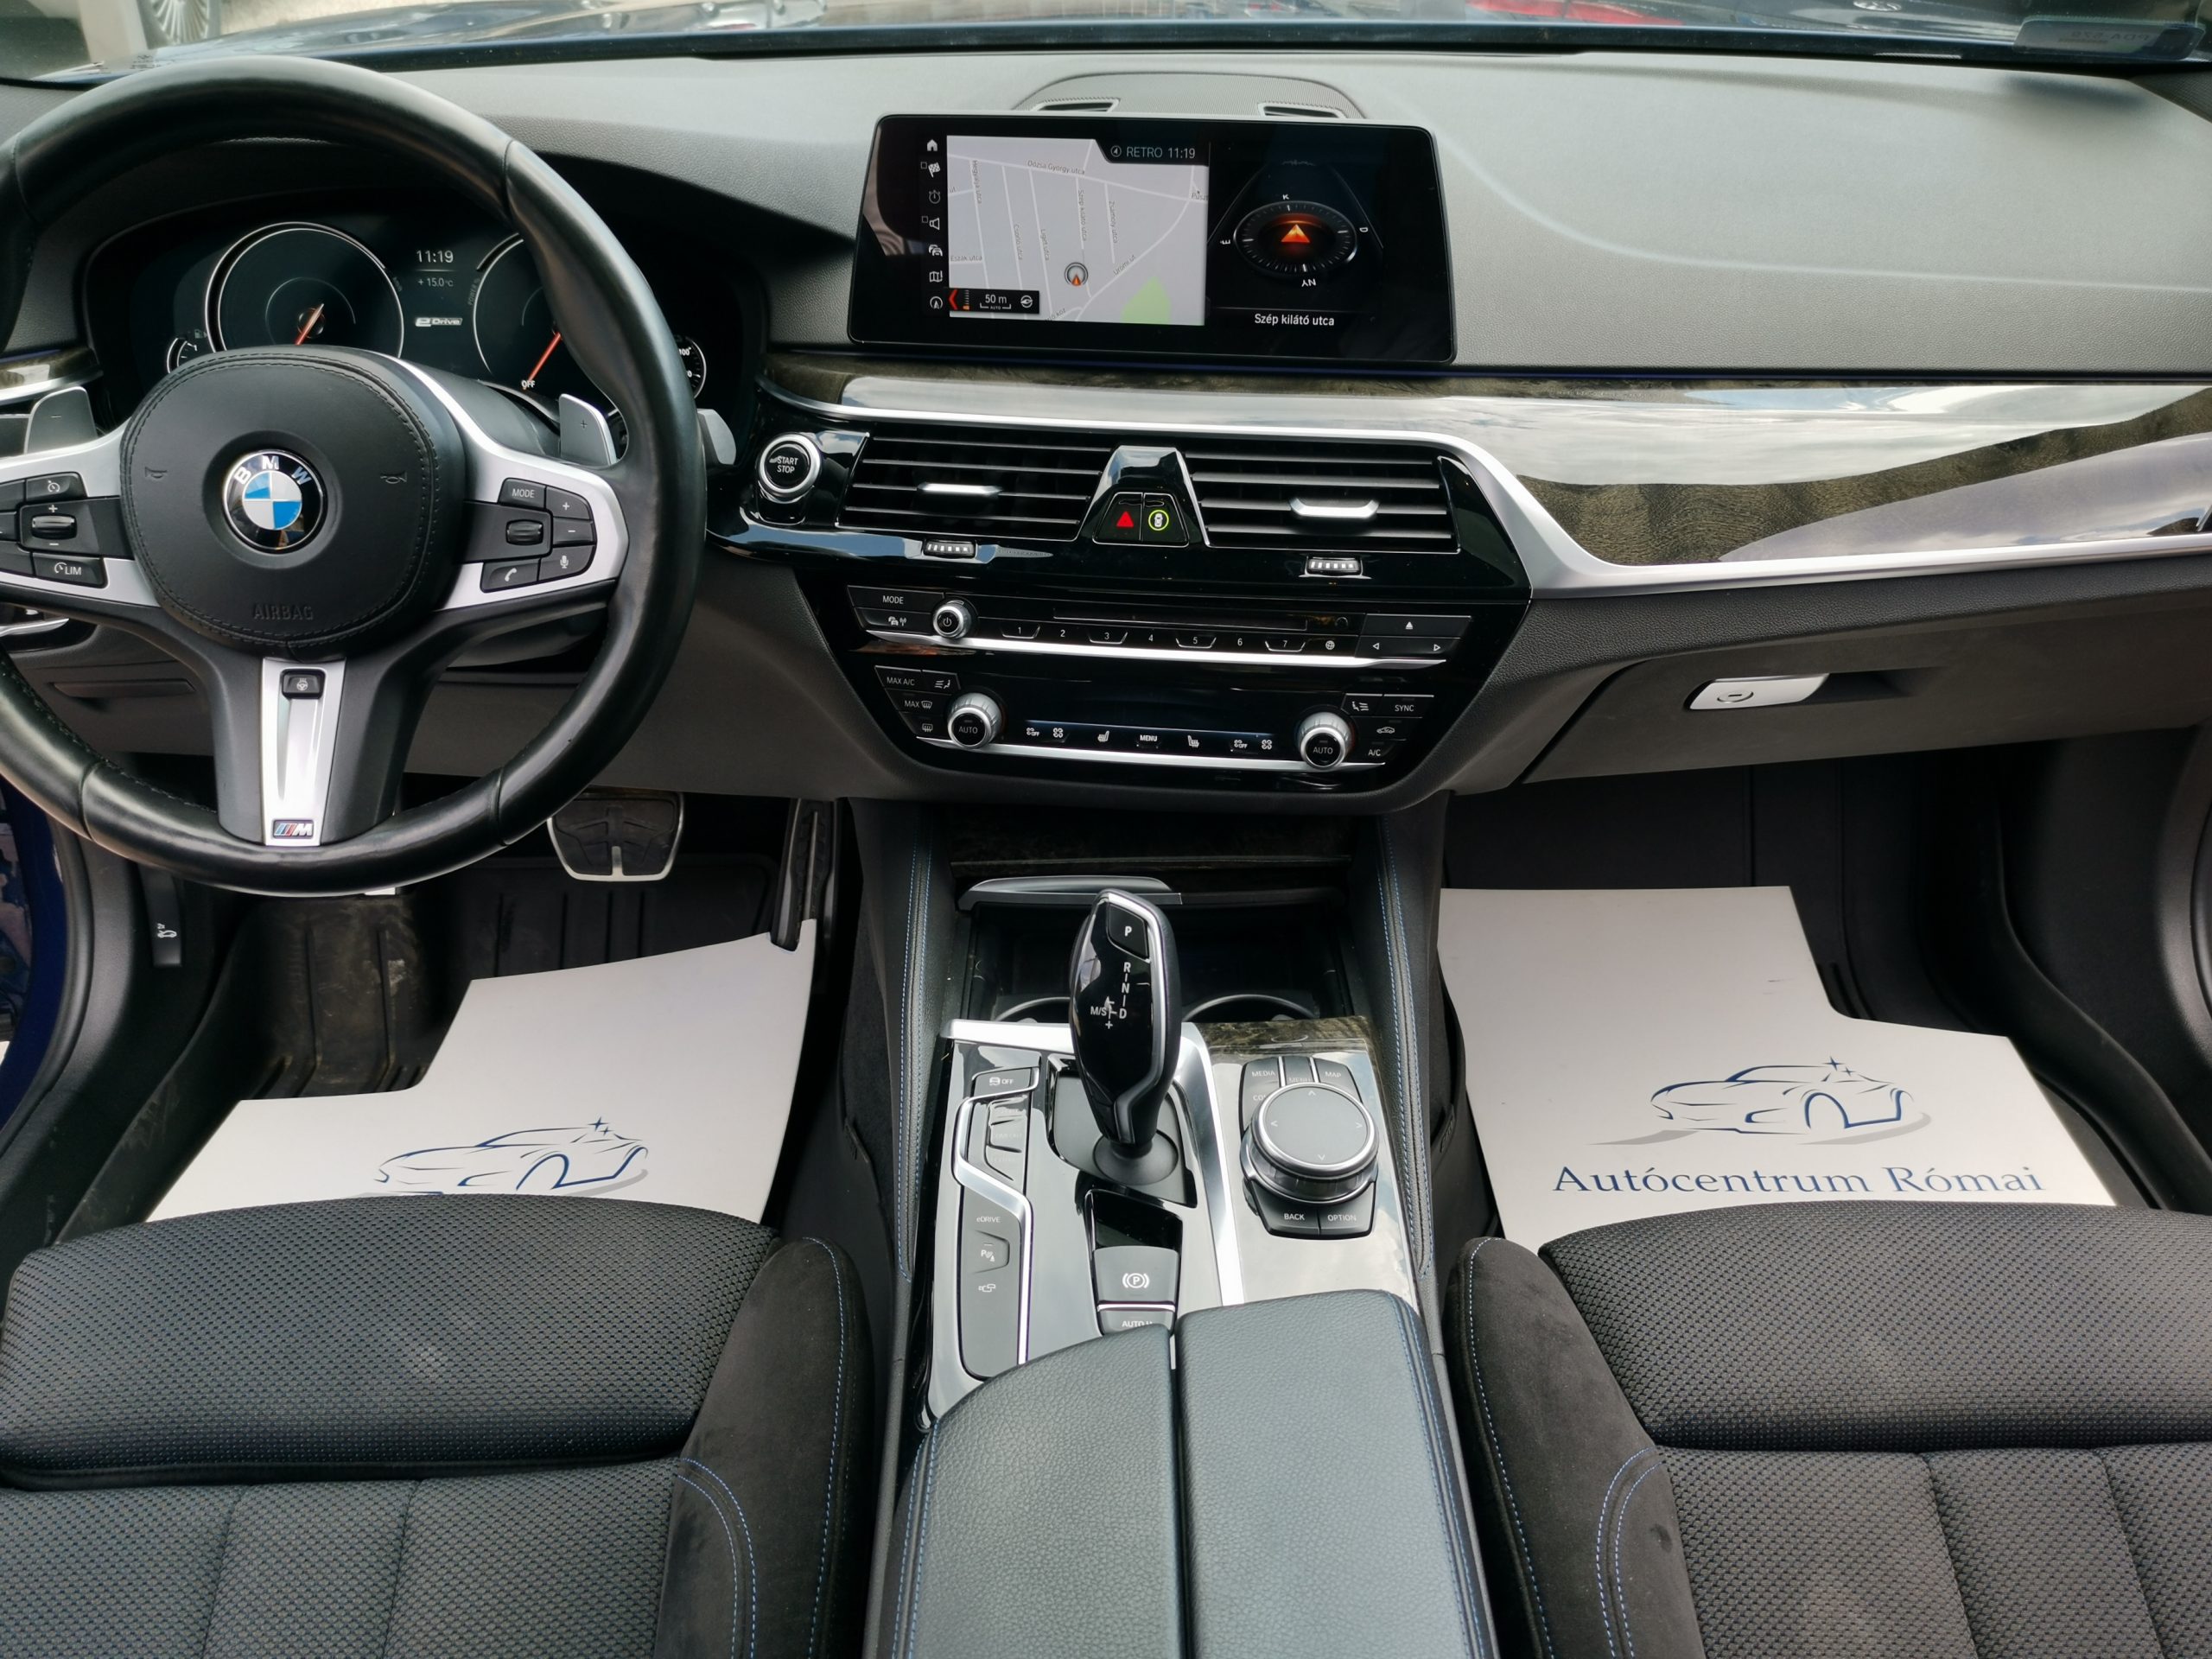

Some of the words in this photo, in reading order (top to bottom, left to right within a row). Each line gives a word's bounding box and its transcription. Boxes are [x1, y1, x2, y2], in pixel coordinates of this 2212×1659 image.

[1126, 145, 1163, 158] RETRO
[1167, 147, 1196, 159] 11:19
[416, 250, 454, 264] 11:19
[426, 277, 445, 287] 15.0
[1301, 278, 1317, 288] NY
[985, 294, 996, 304] 50
[998, 296, 1007, 304] m
[1255, 313, 1279, 327] Szép
[1281, 314, 1310, 326] kilátó
[1313, 315, 1335, 326] utca
[777, 455, 798, 466] START
[233, 454, 312, 486] BMW
[777, 464, 796, 474] STOP
[512, 487, 536, 499] MODE
[64, 566, 82, 575] LIM
[882, 594, 905, 605] MODE
[252, 603, 314, 620] AIRBAG
[1017, 626, 1021, 635] 1
[1059, 629, 1065, 638] 2
[1104, 632, 1110, 640] 3
[1147, 633, 1154, 642] 4
[1192, 636, 1198, 645] 5
[1236, 638, 1243, 646] 6
[1282, 639, 1287, 648] 7
[886, 677, 902, 685] MAX
[904, 700, 919, 709] MAX
[958, 726, 978, 734] AUTO
[1139, 734, 1158, 742] MENU
[1313, 746, 1333, 754] AUTO
[1368, 748, 1382, 757] A/C
[1124, 925, 1133, 938] P
[1123, 961, 1132, 974] R
[1121, 982, 1130, 995] N
[1090, 1006, 1107, 1017] M/S
[1118, 1007, 1128, 1020] D
[1552, 1166, 1873, 1193] Autócentrum
[1880, 1165, 2046, 1193] Római
[976, 1215, 1001, 1224] eDRIVE
[1283, 1212, 1306, 1221] BACK
[1122, 1319, 1145, 1328] AUTO
